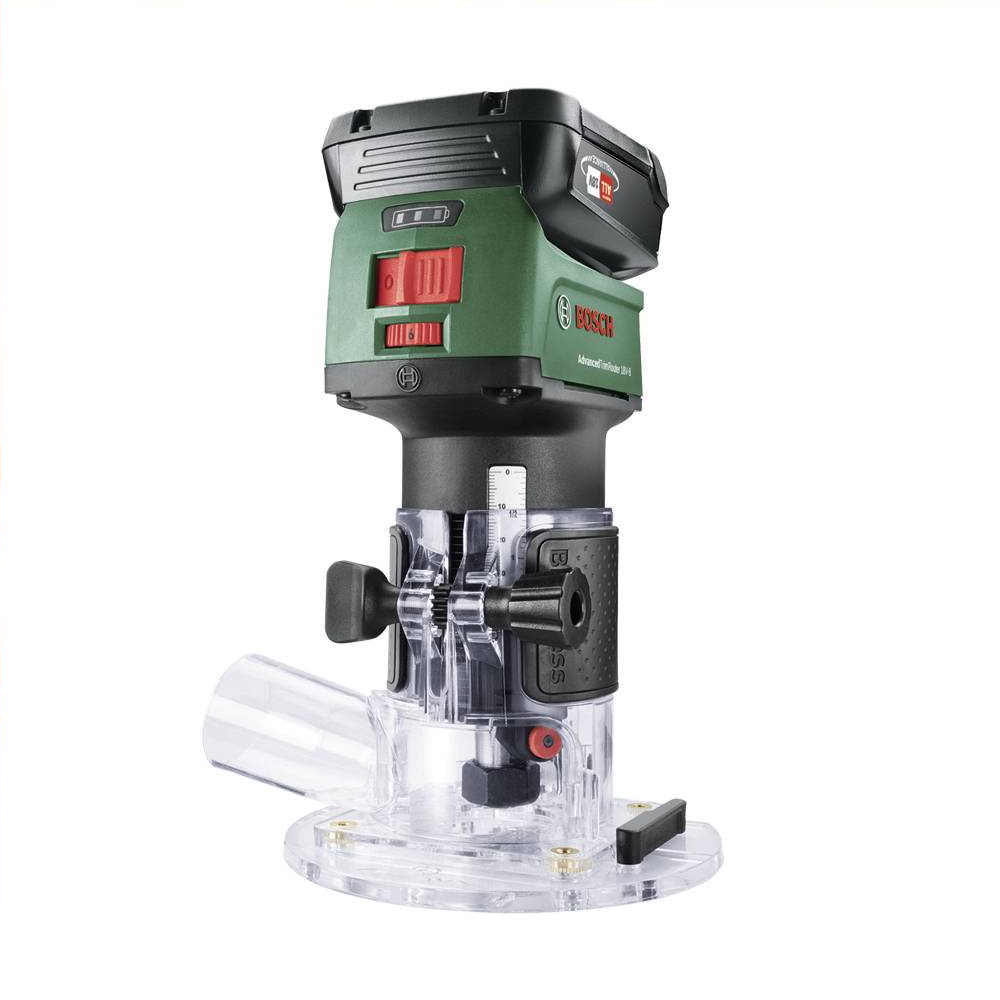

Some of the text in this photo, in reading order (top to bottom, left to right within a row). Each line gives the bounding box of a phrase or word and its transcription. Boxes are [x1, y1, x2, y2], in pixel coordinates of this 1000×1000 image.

[589, 175, 612, 196] ALL 18V
[575, 304, 614, 338] BOSCH
[509, 510, 518, 518] 1/2
